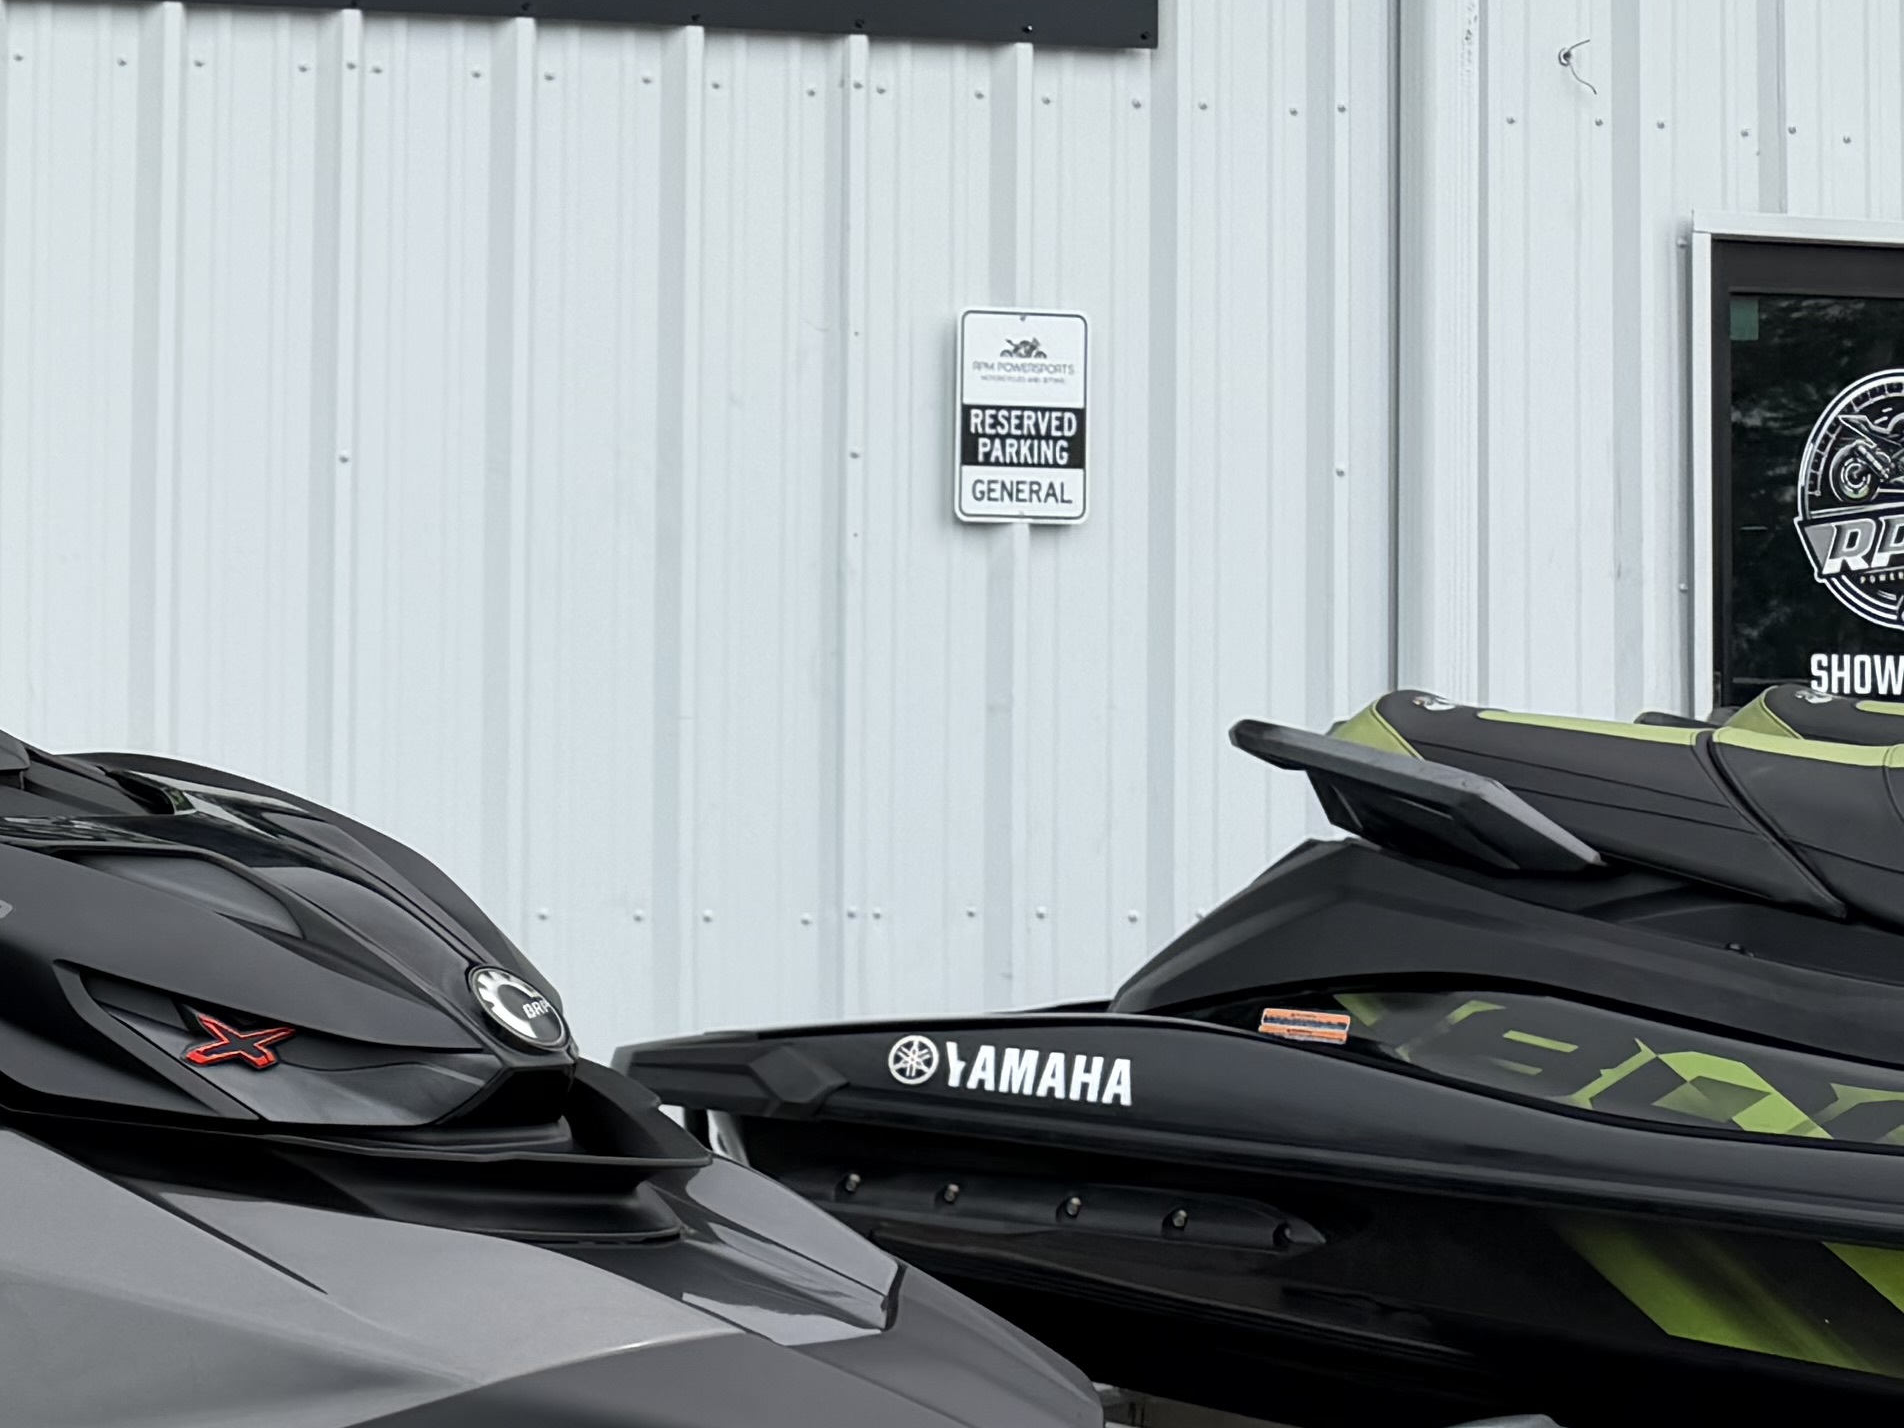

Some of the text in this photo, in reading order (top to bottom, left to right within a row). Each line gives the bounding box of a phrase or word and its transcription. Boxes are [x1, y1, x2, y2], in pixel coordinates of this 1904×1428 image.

[970, 408, 1077, 437] RESERVED
[977, 437, 1069, 466] PARKING
[971, 479, 1073, 504] GENERAL
[1810, 653, 1904, 695] SHOW
[945, 1040, 1133, 1107] YAMAHA
